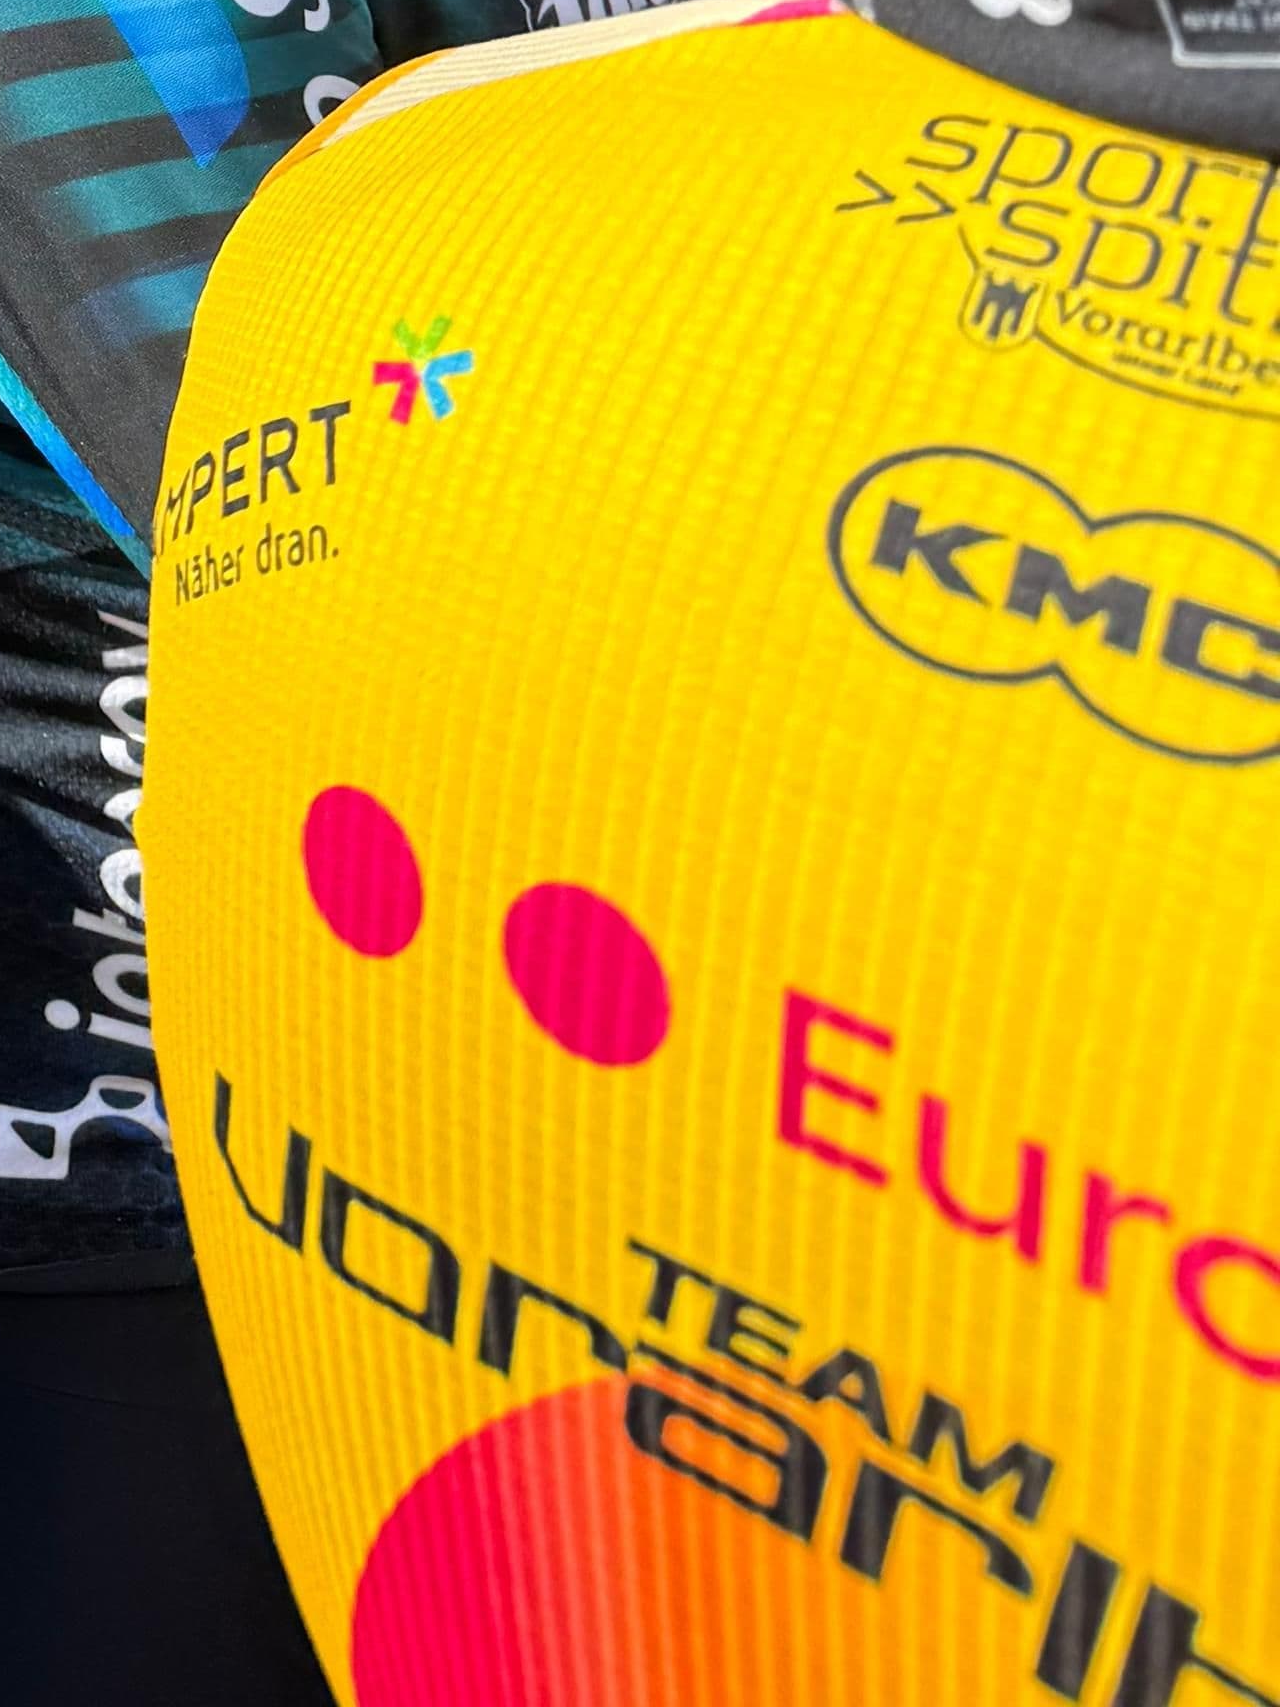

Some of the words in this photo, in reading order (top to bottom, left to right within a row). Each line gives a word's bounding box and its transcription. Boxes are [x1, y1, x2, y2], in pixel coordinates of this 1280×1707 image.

[985, 199, 1280, 329] spit
[153, 399, 352, 563] MPERT
[175, 543, 245, 607] Näher
[255, 522, 340, 576] dran.
[870, 499, 1280, 707] KMC
[626, 1236, 1057, 1522] TEAM
